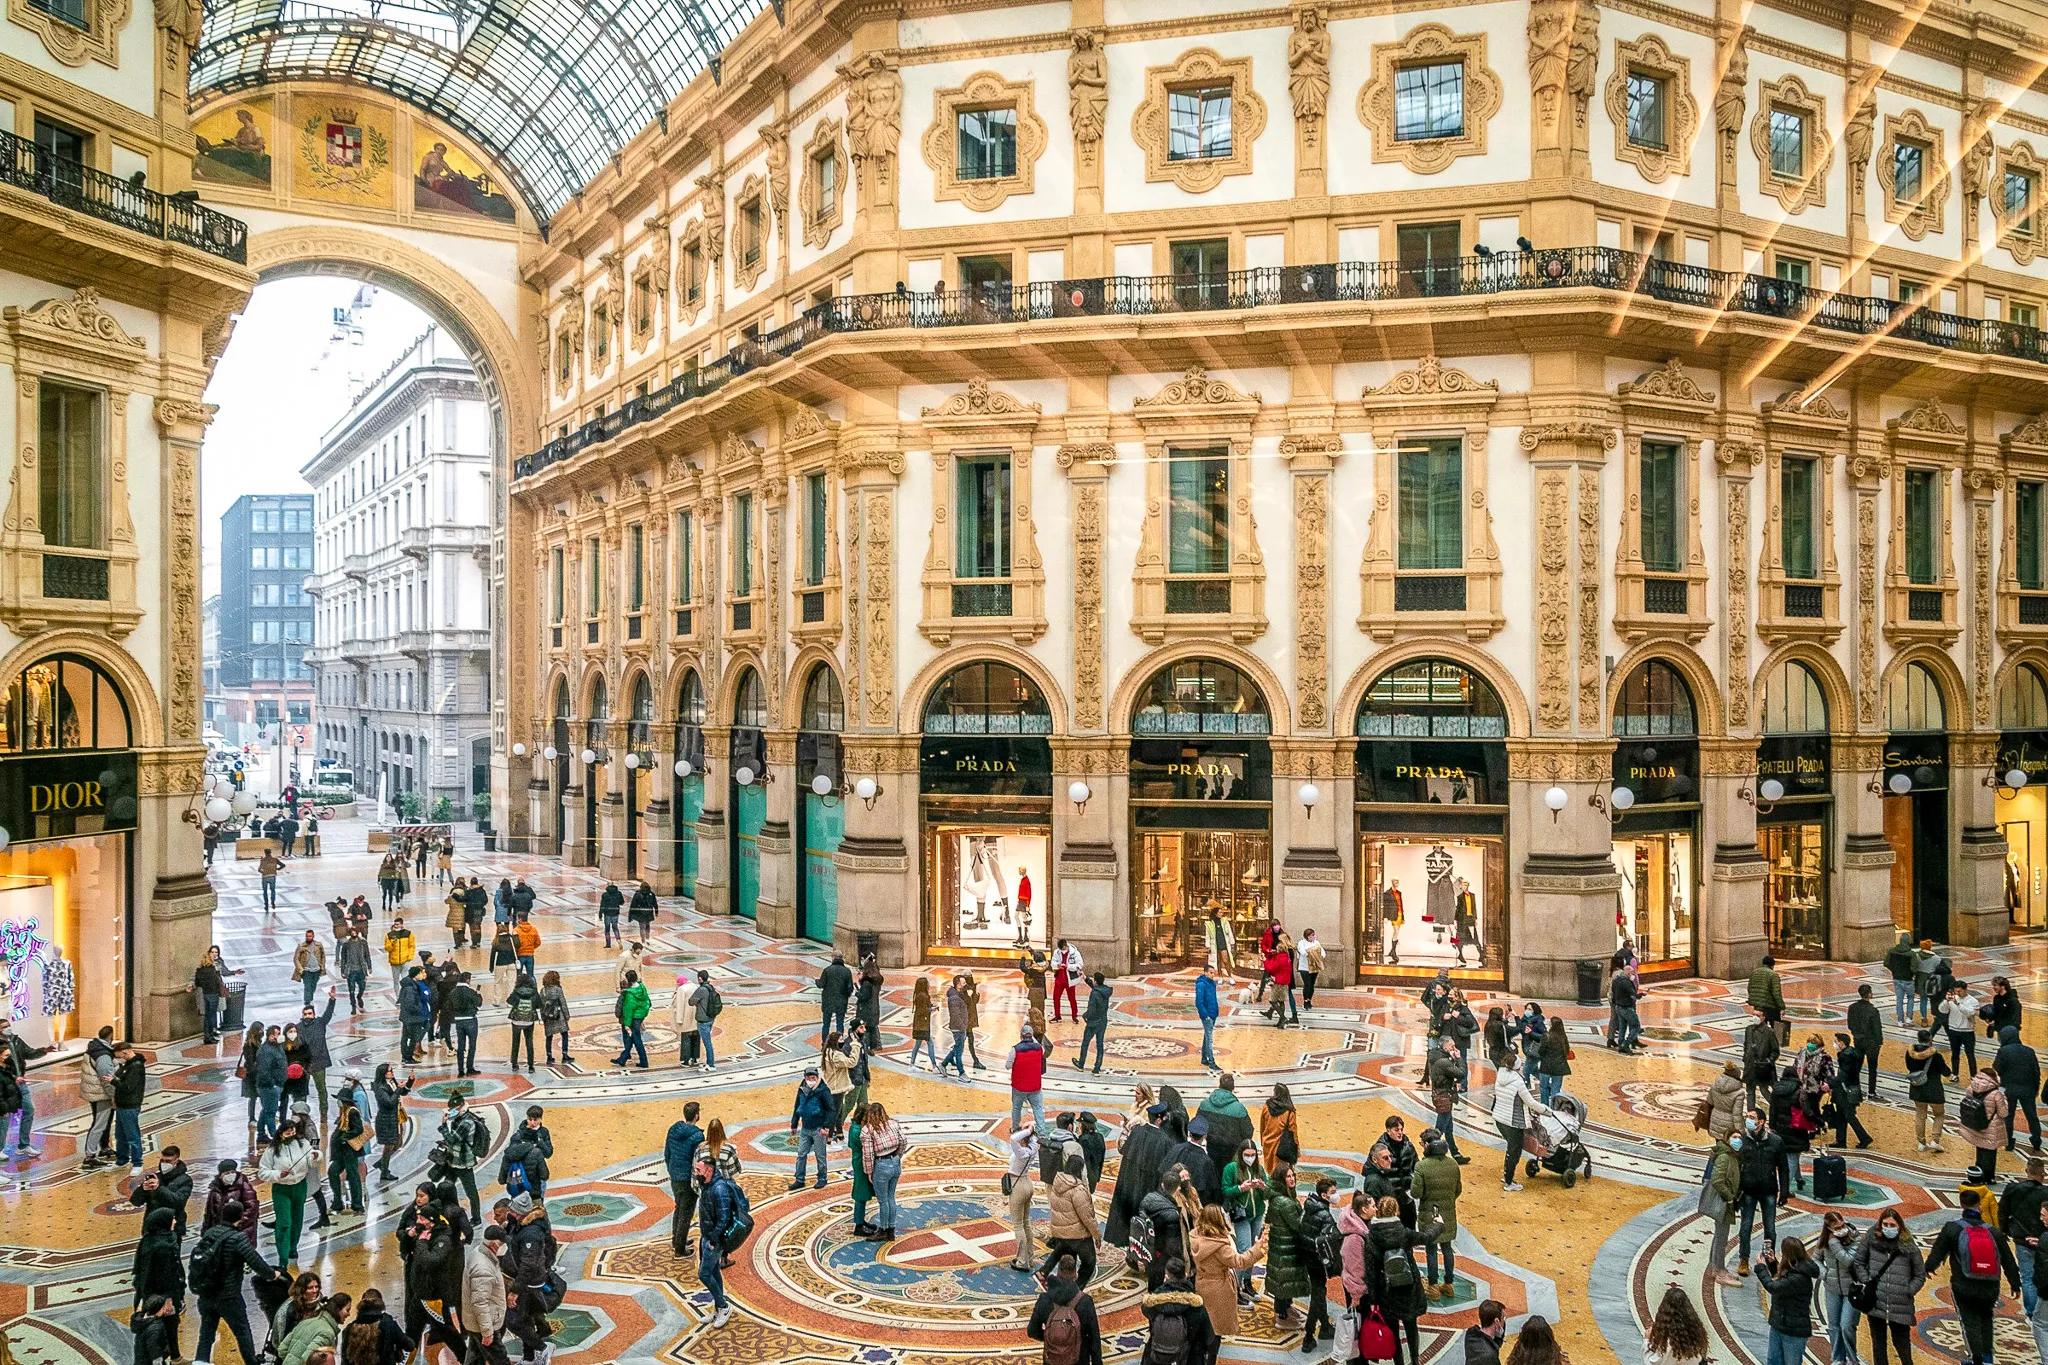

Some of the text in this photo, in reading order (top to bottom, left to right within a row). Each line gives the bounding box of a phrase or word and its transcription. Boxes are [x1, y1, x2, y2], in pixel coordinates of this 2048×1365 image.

[956, 760, 1017, 772] PRADA
[1756, 756, 1824, 774] FRATELLI PRADA
[1882, 752, 1943, 767] Santoni
[1168, 763, 1233, 776] PRADA
[1396, 765, 1467, 779] PRADA
[1630, 766, 1676, 779] PRADA
[30, 781, 104, 813] DIOR
